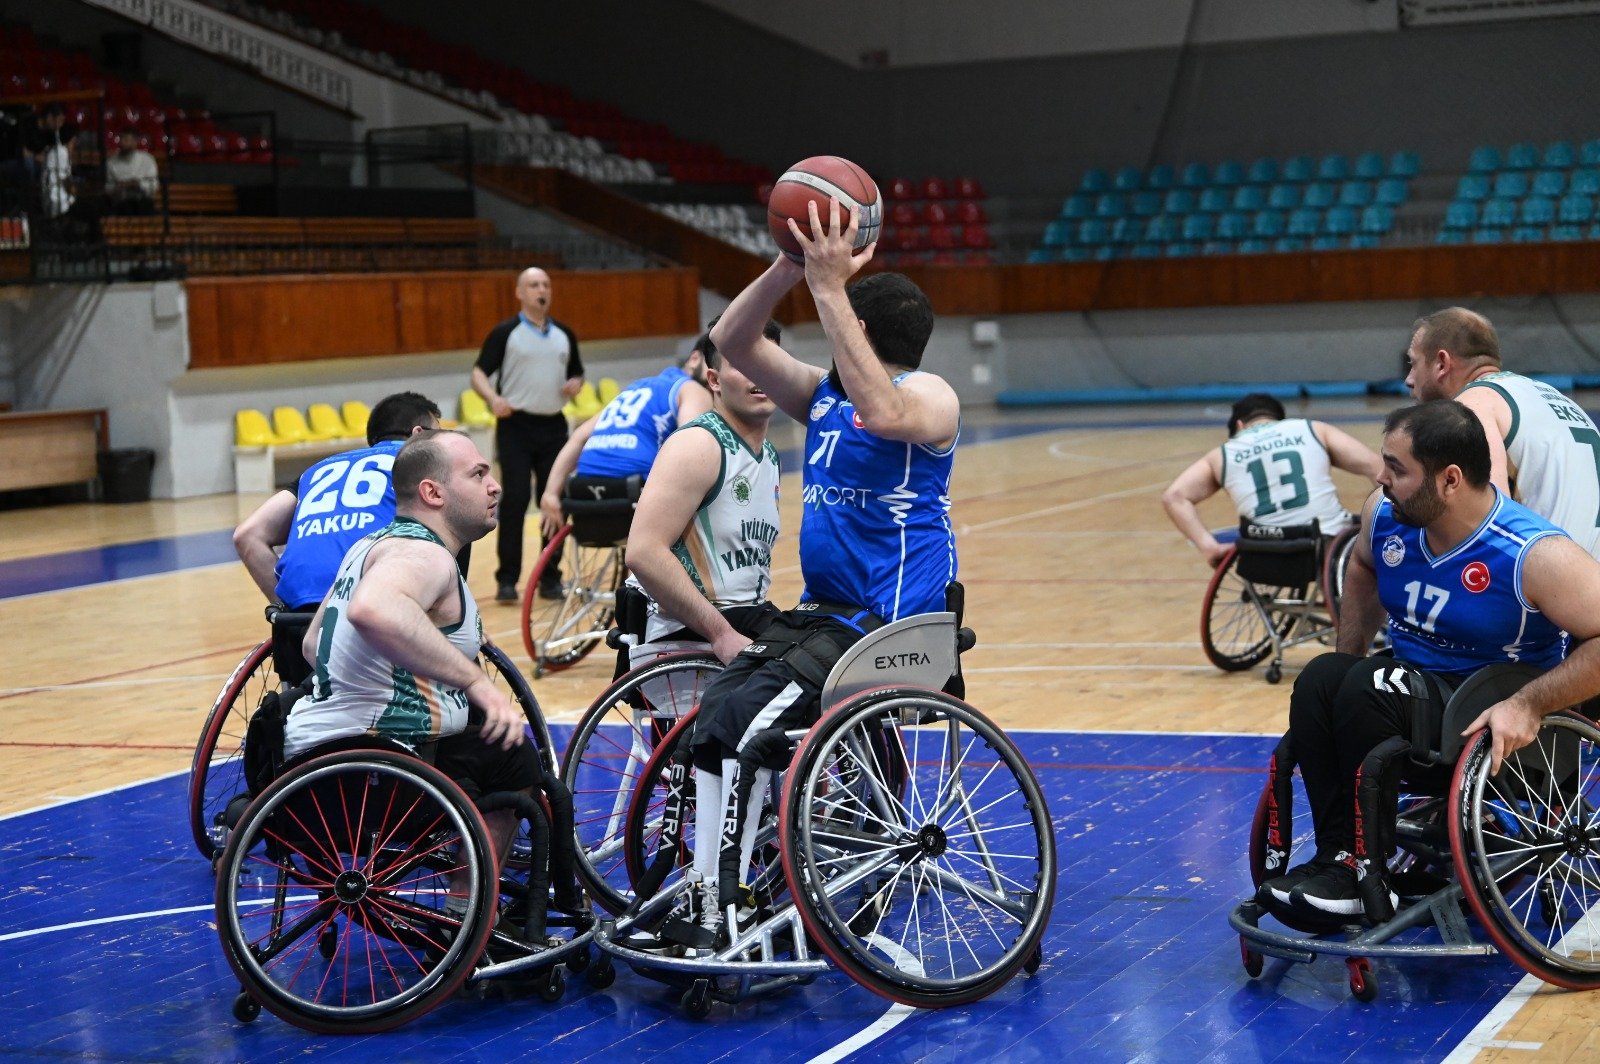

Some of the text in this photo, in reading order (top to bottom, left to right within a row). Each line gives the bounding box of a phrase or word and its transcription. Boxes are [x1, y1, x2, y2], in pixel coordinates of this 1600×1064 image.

[808, 430, 841, 468] 77
[297, 453, 396, 522] 26
[1246, 450, 1310, 517] 13
[297, 512, 375, 539] YAKUP
[1403, 580, 1450, 633] 17
[874, 652, 931, 670] EXTRA
[660, 764, 685, 851] EXTRA
[720, 762, 741, 852] EXTRA
